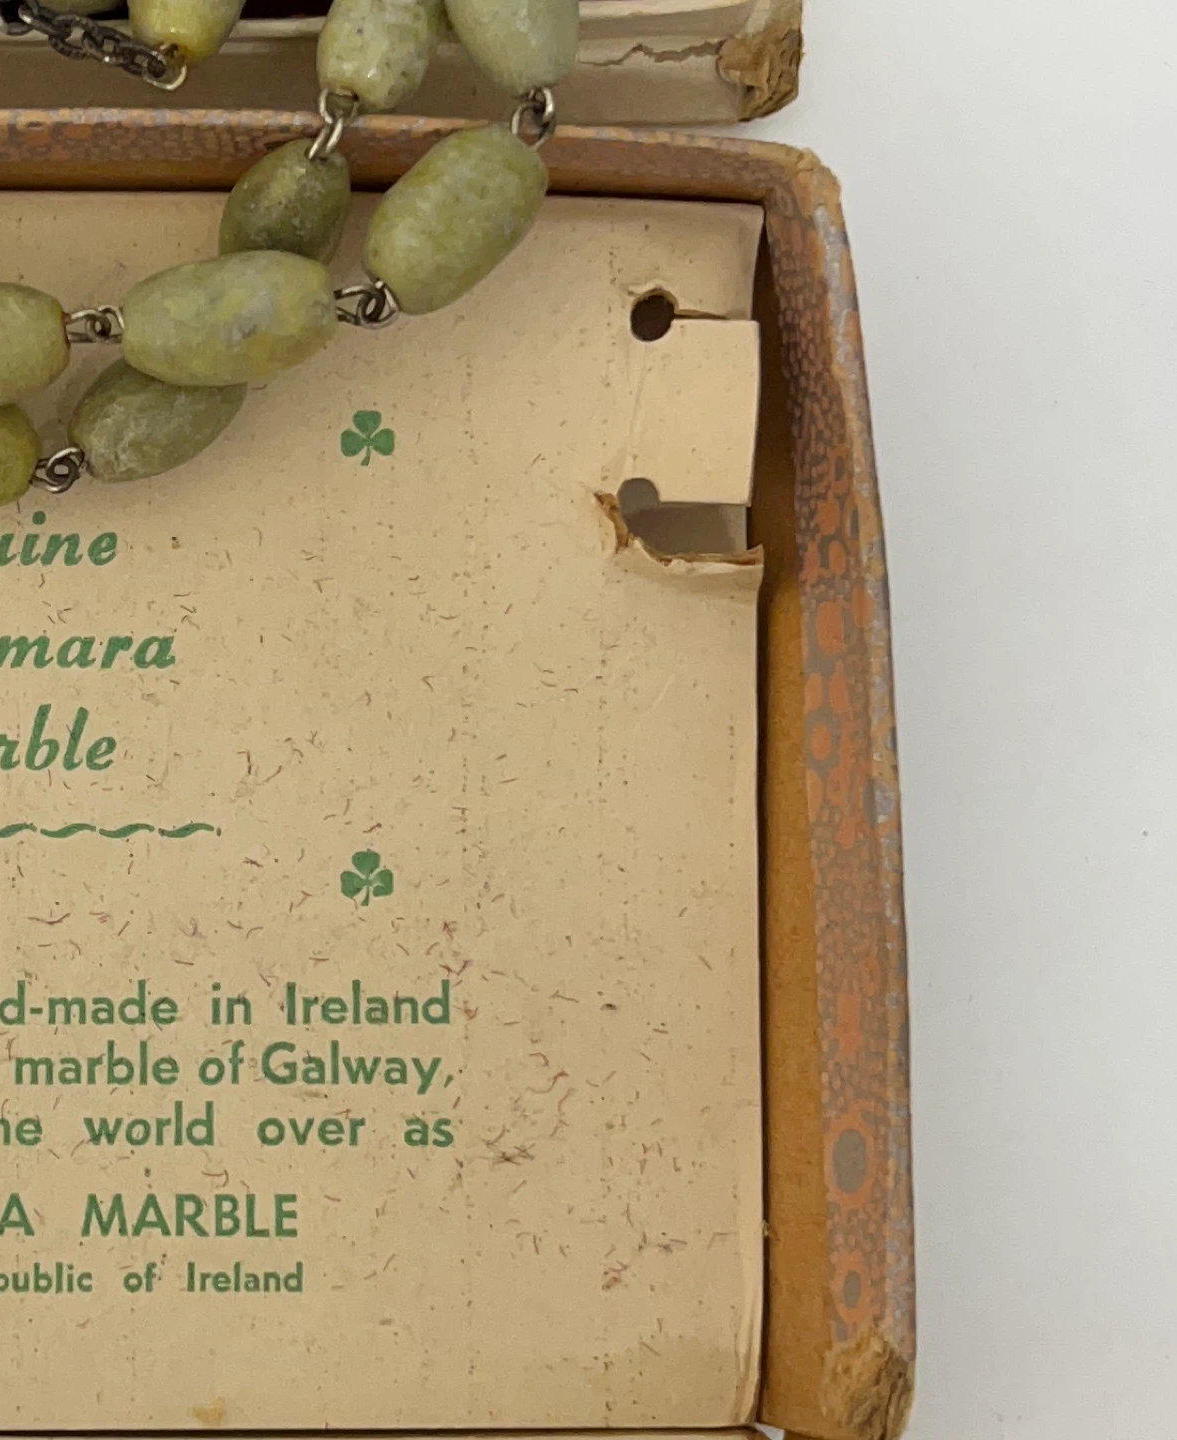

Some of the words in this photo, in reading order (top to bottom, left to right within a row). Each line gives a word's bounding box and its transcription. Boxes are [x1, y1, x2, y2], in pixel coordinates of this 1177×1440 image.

[212, 982, 252, 1025] in
[285, 979, 451, 1025] Ireland
[14, 1040, 179, 1086] marble
[198, 1040, 245, 1085] of
[260, 1040, 454, 1095] Galway,
[83, 1100, 215, 1147] world
[257, 1116, 366, 1146] over
[404, 1116, 455, 1148] as
[81, 1193, 298, 1238] MARBLE
[123, 1262, 156, 1293] of
[186, 1262, 304, 1293] Ireland
